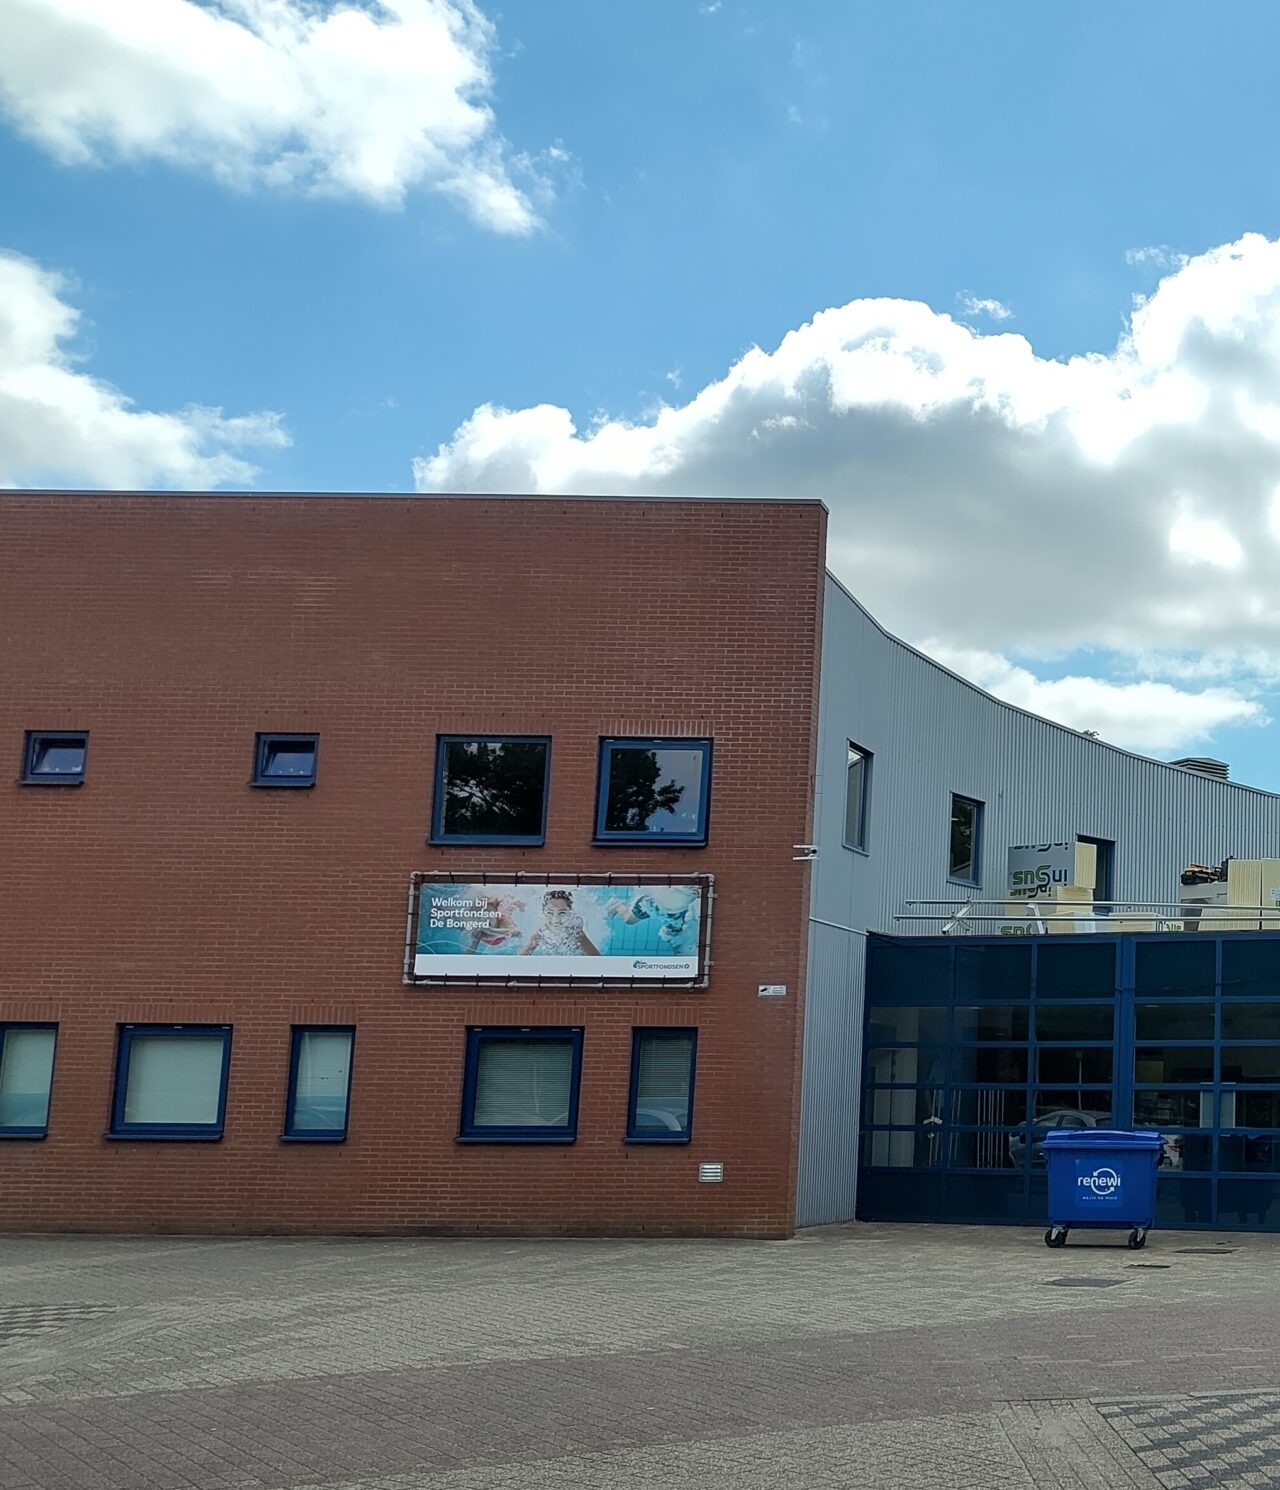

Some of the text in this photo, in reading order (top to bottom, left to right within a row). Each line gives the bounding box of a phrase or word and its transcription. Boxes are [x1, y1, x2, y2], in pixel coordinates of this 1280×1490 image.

[431, 897, 488, 910] Welkom bij
[430, 908, 502, 919] Sportfondsen
[430, 919, 490, 931] De Bongerd
[1078, 1173, 1121, 1188] renewi
